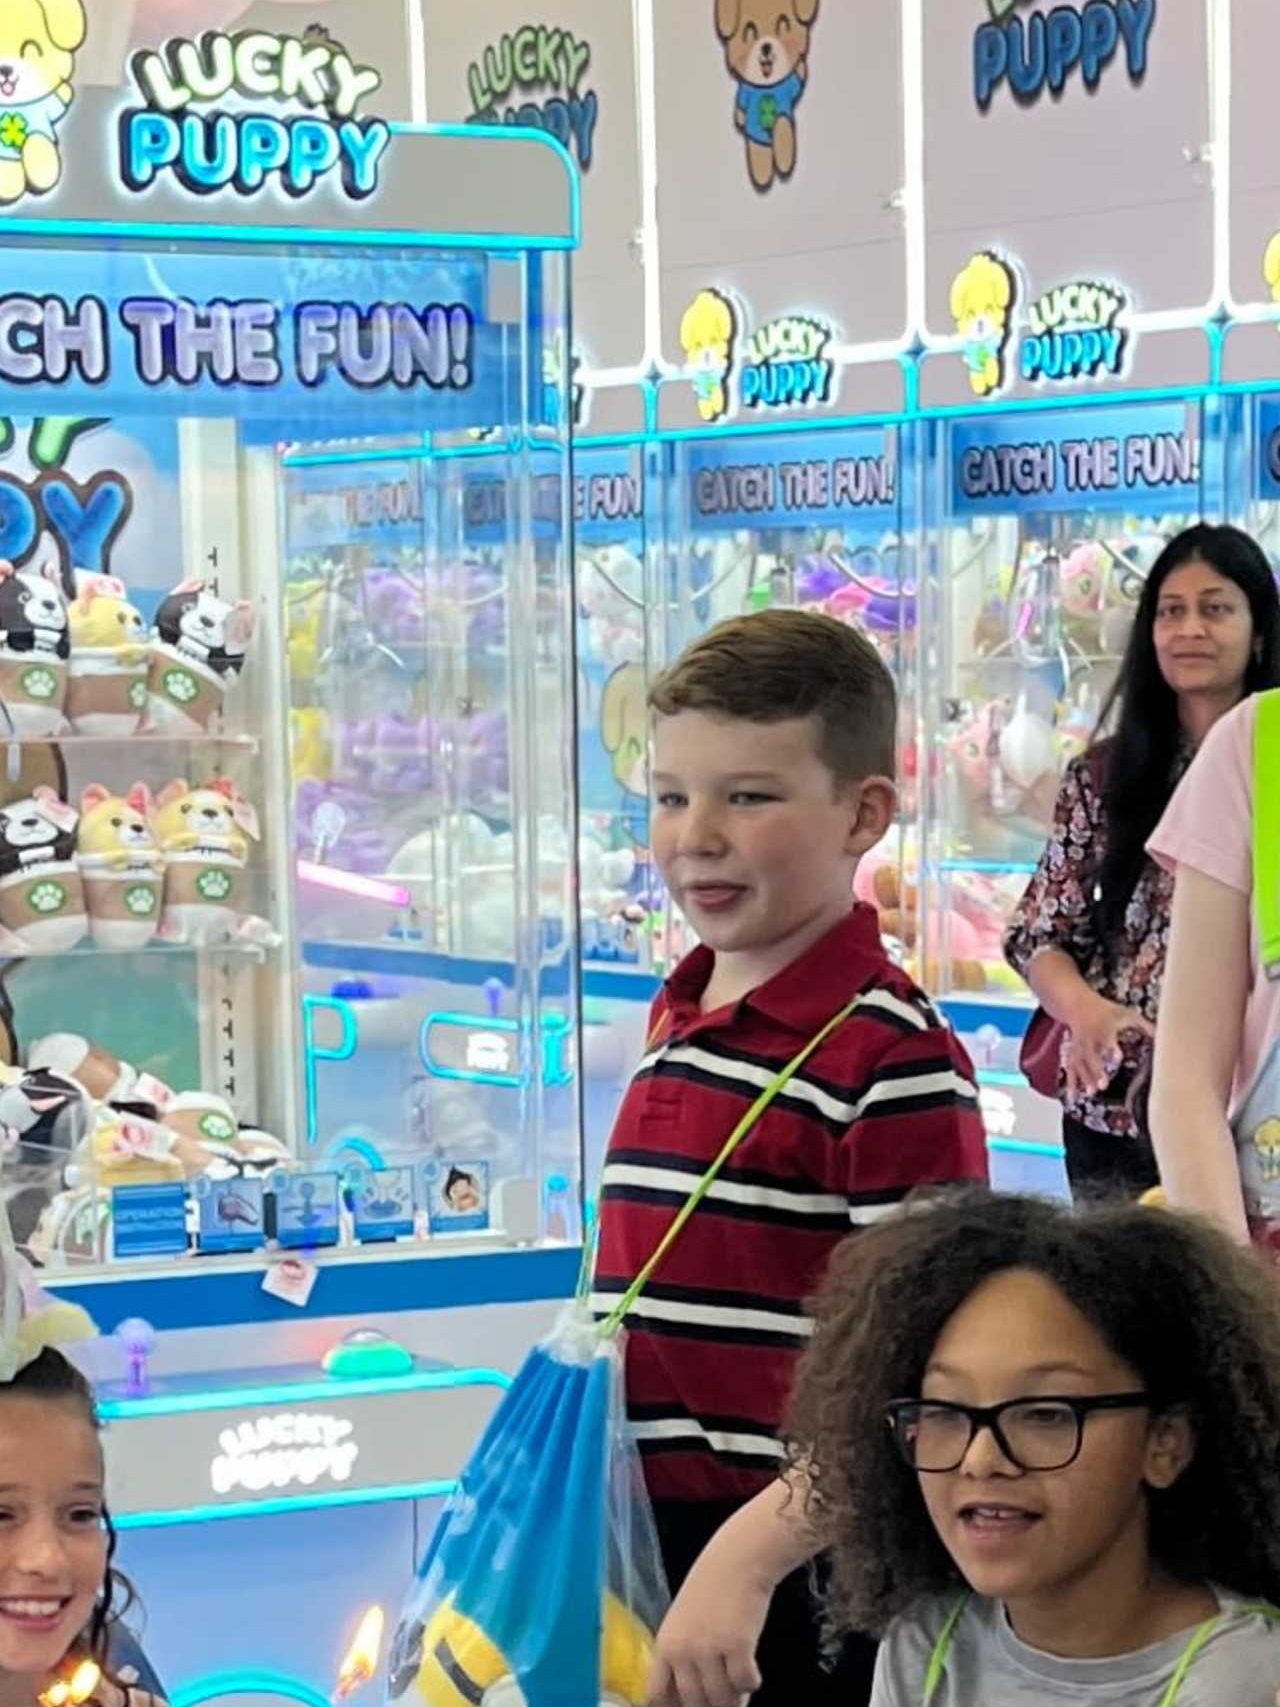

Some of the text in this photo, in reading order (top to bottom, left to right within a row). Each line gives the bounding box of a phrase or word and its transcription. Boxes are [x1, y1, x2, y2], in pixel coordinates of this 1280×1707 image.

[129, 29, 382, 118] LUCKY
[467, 24, 591, 110] LUCKY
[119, 105, 390, 200] PUPPY
[748, 317, 830, 363] LUCKY
[1024, 283, 1126, 335] LUCKY
[120, 294, 282, 387] THE
[295, 298, 476, 390] FUN!
[1019, 327, 1128, 381] PUPPY
[740, 355, 832, 408] PUPPY
[696, 455, 898, 517] CATCH THE FUN!
[960, 431, 1202, 499] CATCH THE FUN!
